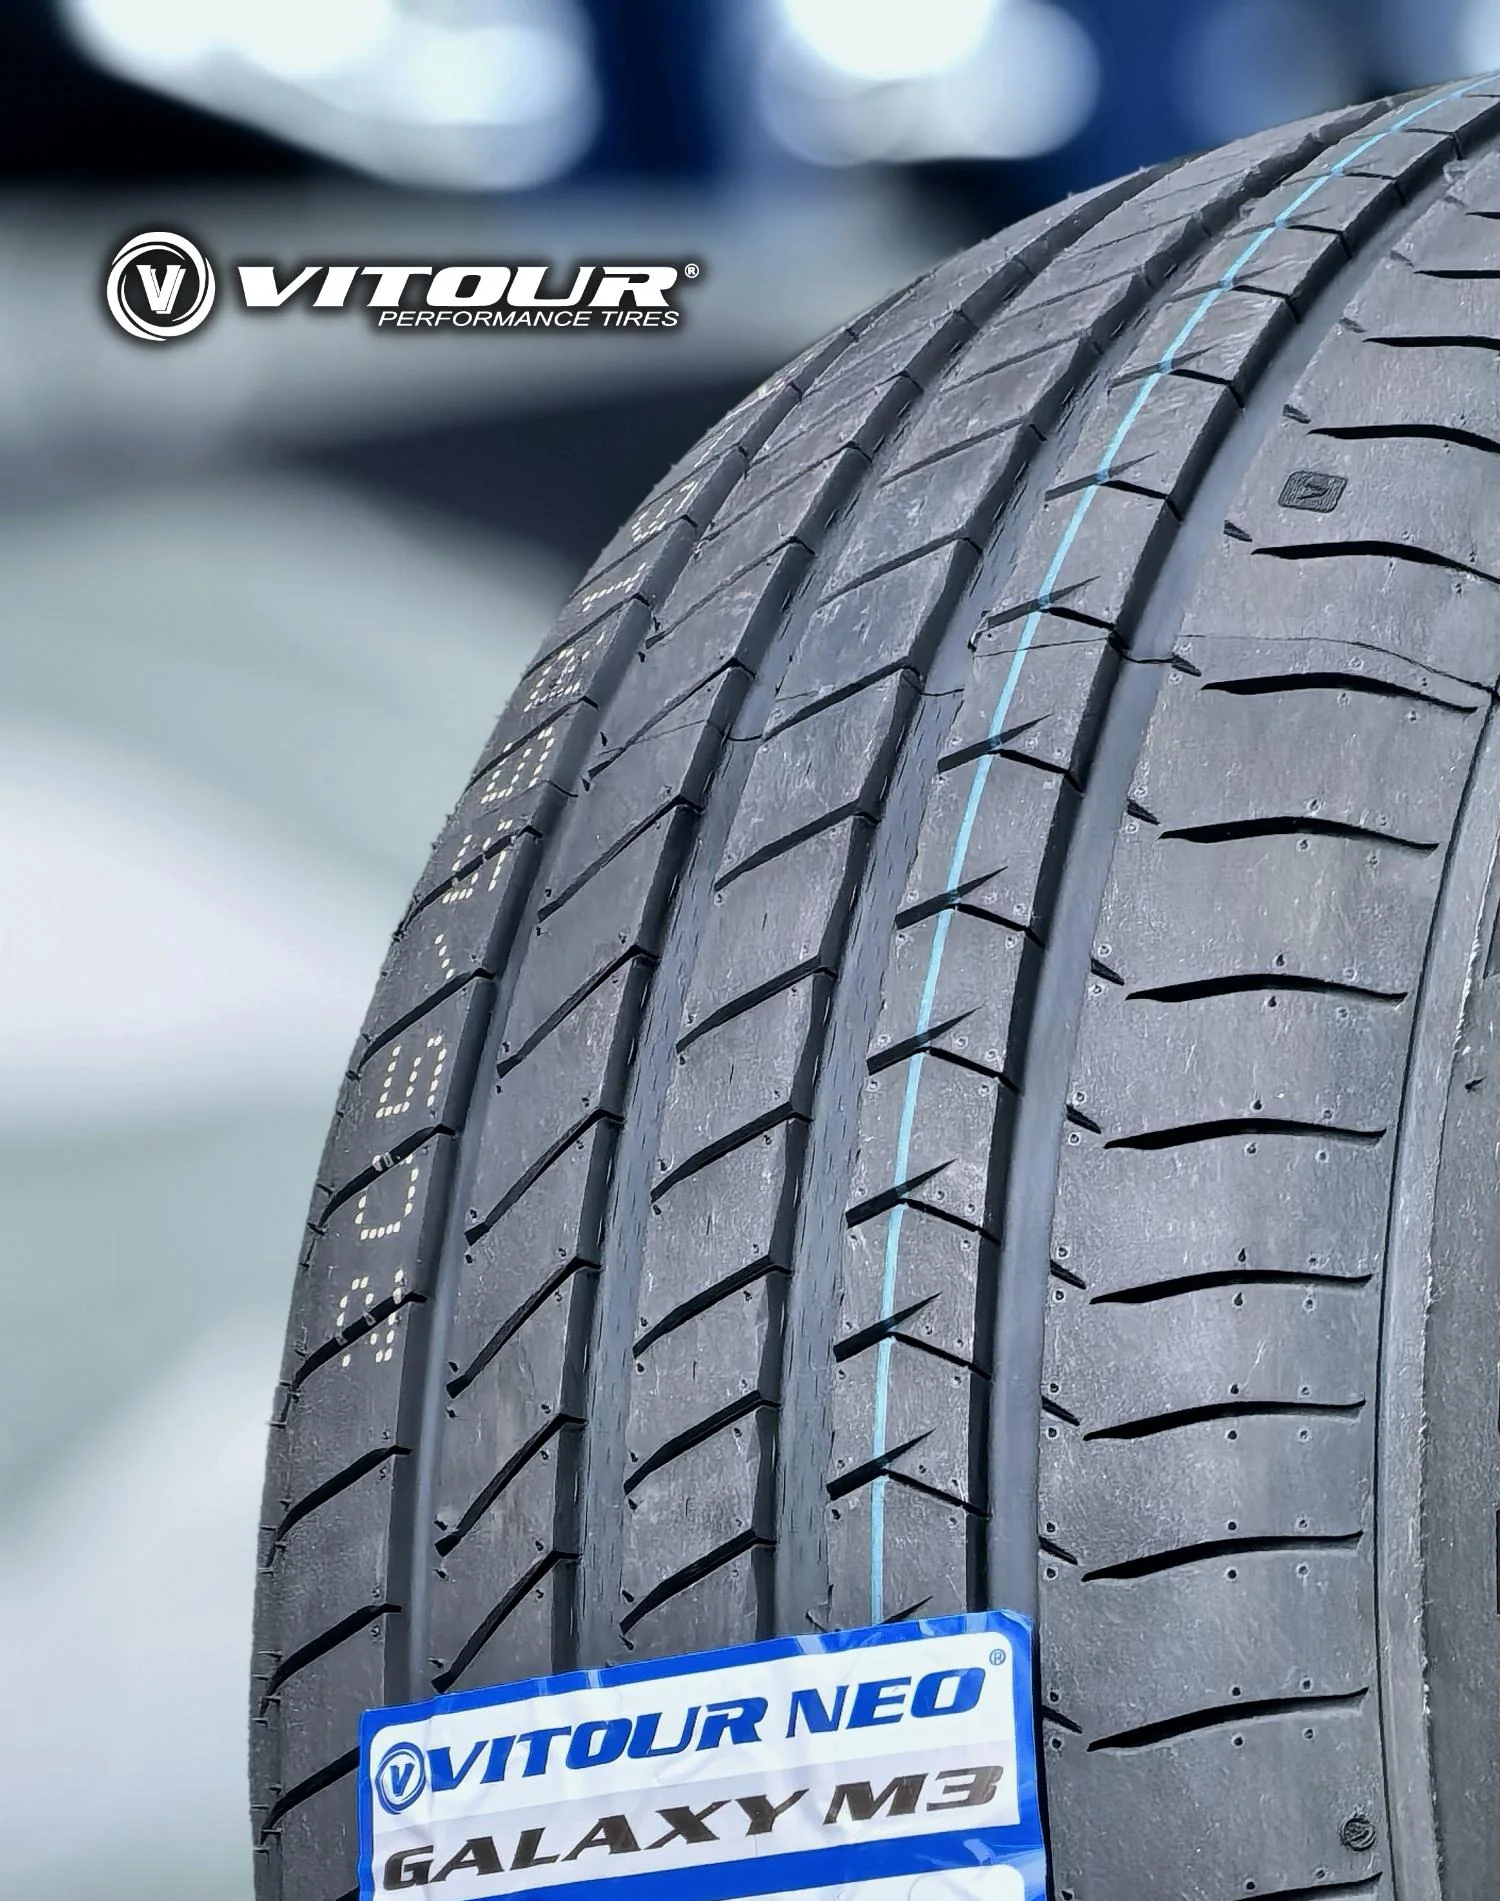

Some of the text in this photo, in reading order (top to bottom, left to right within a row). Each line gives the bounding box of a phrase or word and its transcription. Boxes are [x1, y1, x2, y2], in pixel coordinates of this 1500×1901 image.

[425, 1693, 769, 1792] VITOUR
[785, 1667, 987, 1738] NEO
[383, 1765, 1004, 1892] GALAXY M3
